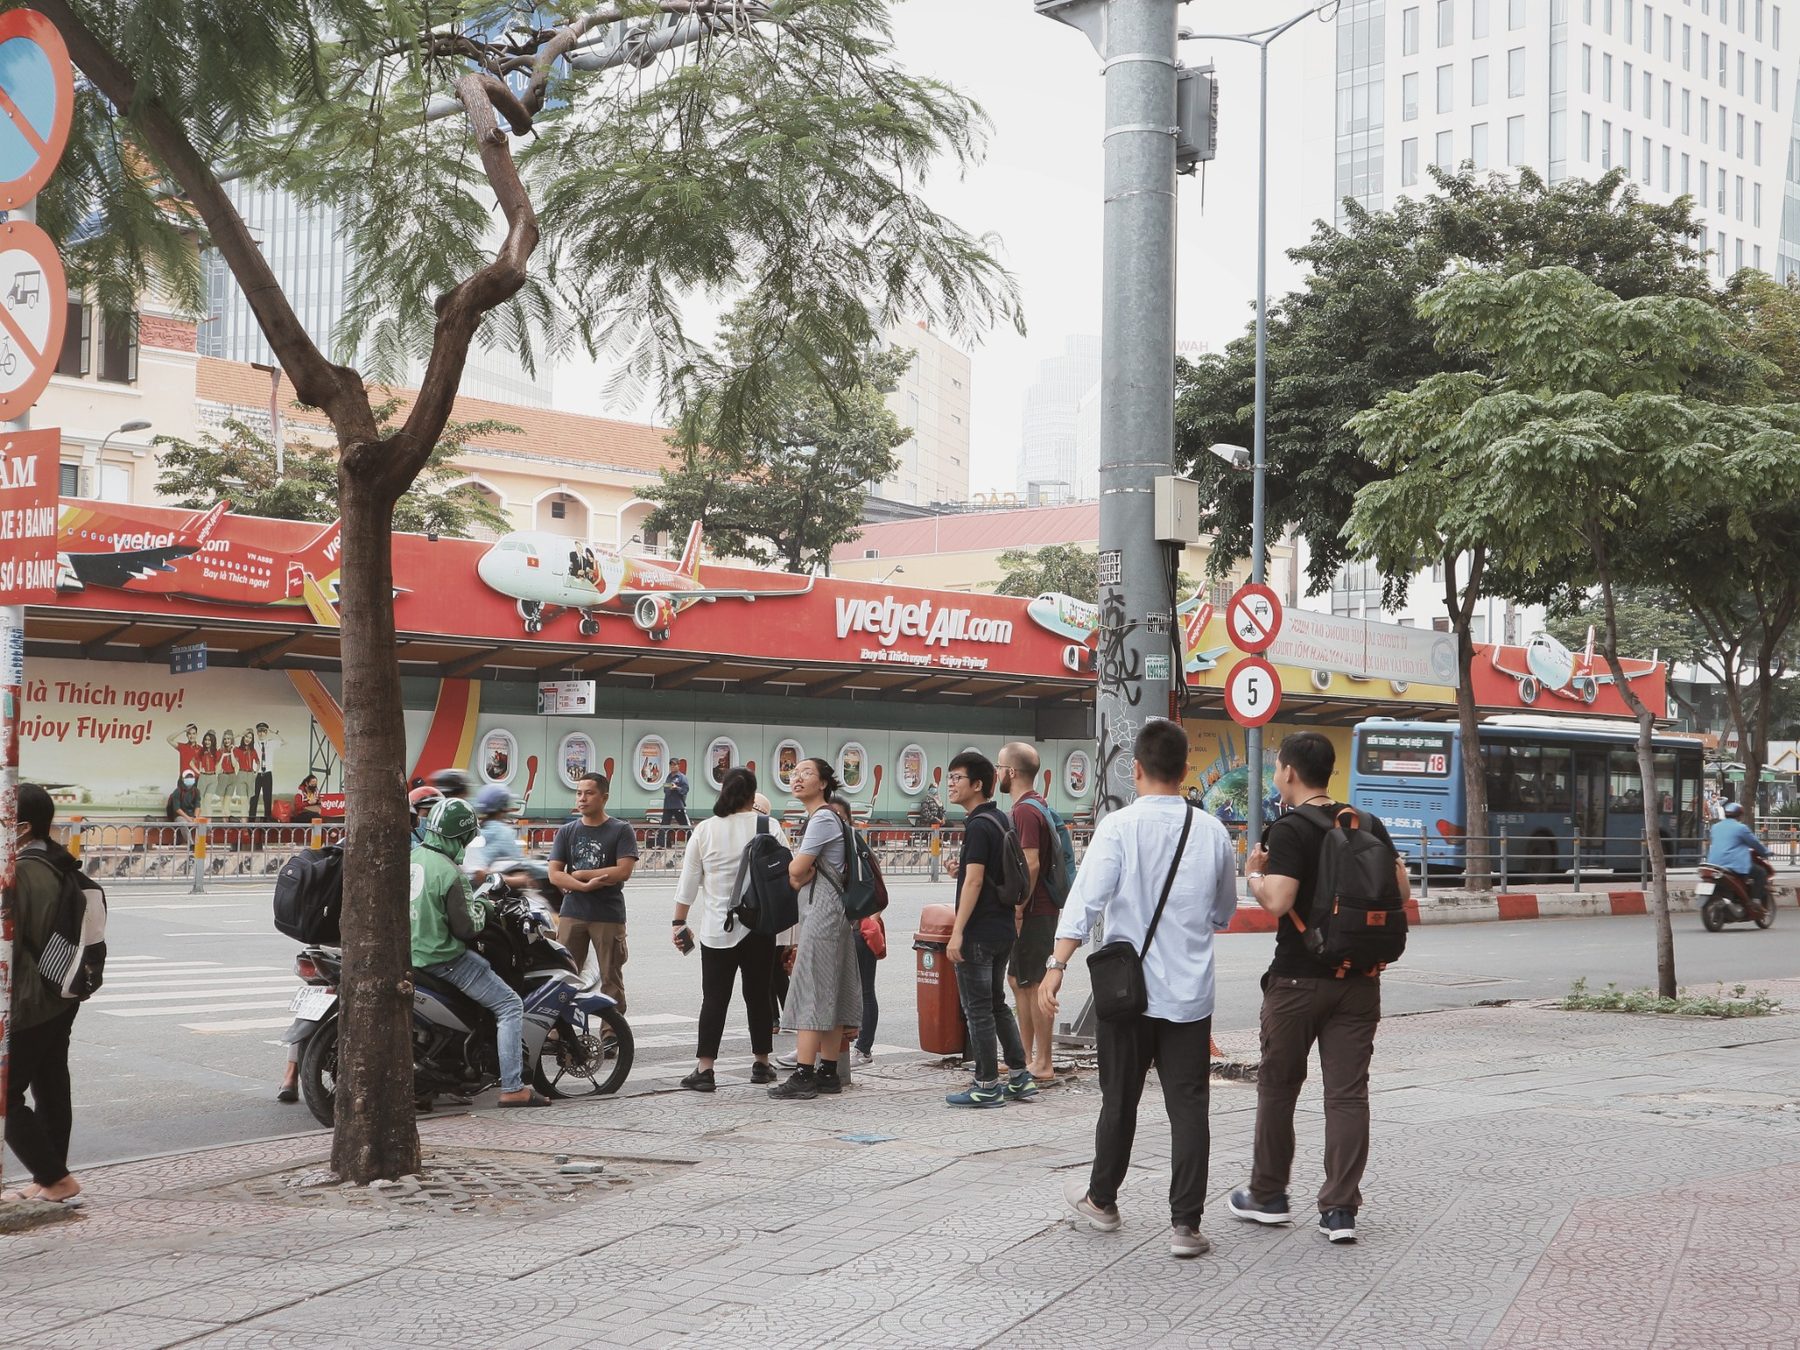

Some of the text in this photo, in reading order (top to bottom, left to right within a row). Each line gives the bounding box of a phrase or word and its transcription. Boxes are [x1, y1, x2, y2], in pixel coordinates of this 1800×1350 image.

[1, 499, 55, 540] XE 3 BÁNH
[16, 561, 23, 590] 4
[26, 551, 55, 589] BÁNH
[203, 567, 270, 588] Bay là Thích ngay!
[26, 679, 185, 712] là Thích ngay!
[1247, 678, 1258, 706] 5
[20, 715, 153, 744] njoy Flying!
[1431, 756, 1444, 771] 18
